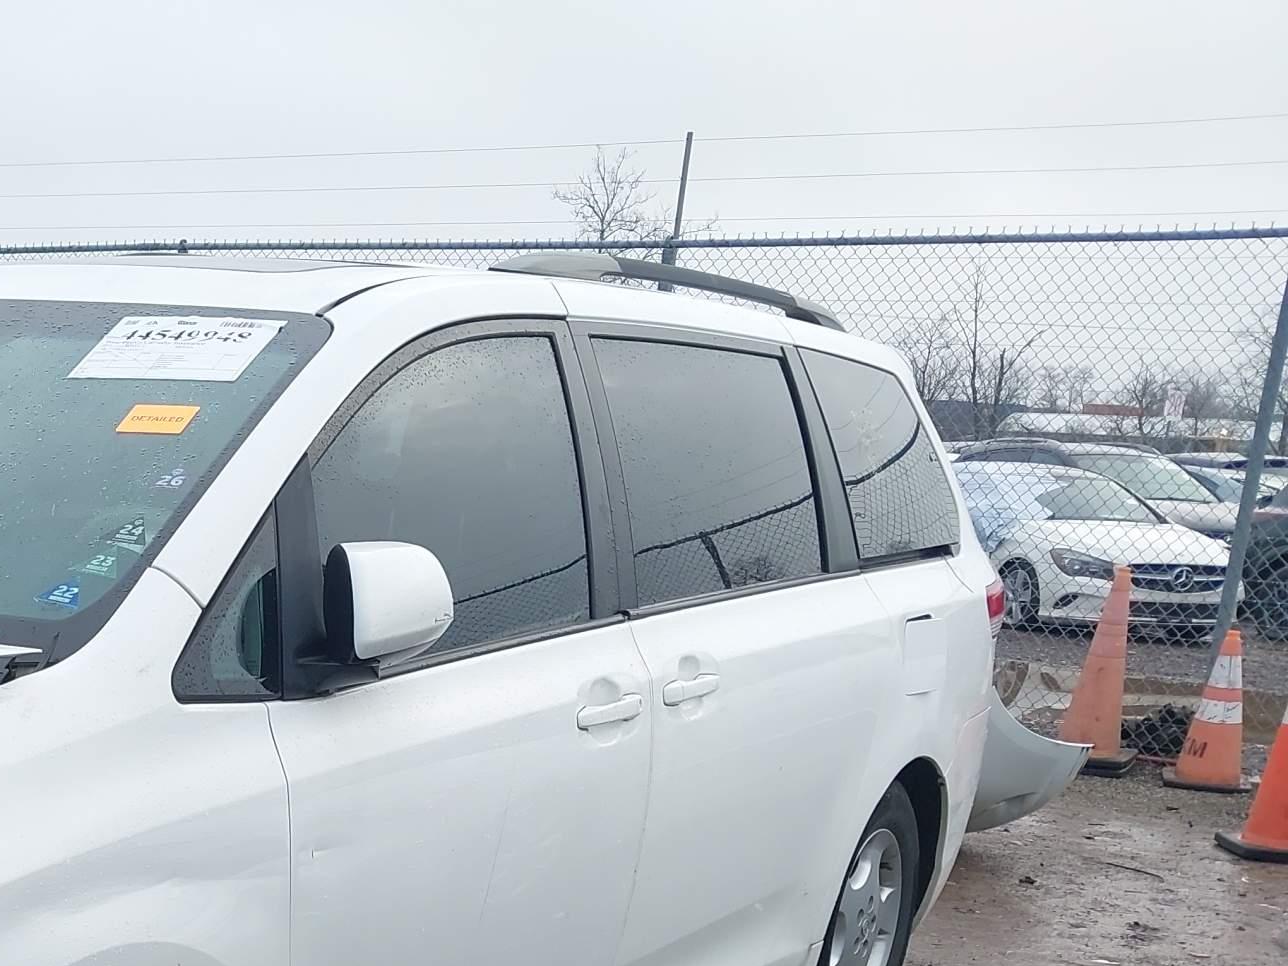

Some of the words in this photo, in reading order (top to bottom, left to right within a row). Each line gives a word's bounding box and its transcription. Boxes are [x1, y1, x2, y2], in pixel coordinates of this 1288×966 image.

[155, 475, 186, 486] 26
[119, 524, 144, 535] 24
[90, 554, 116, 566] 23
[52, 585, 79, 598] 22
